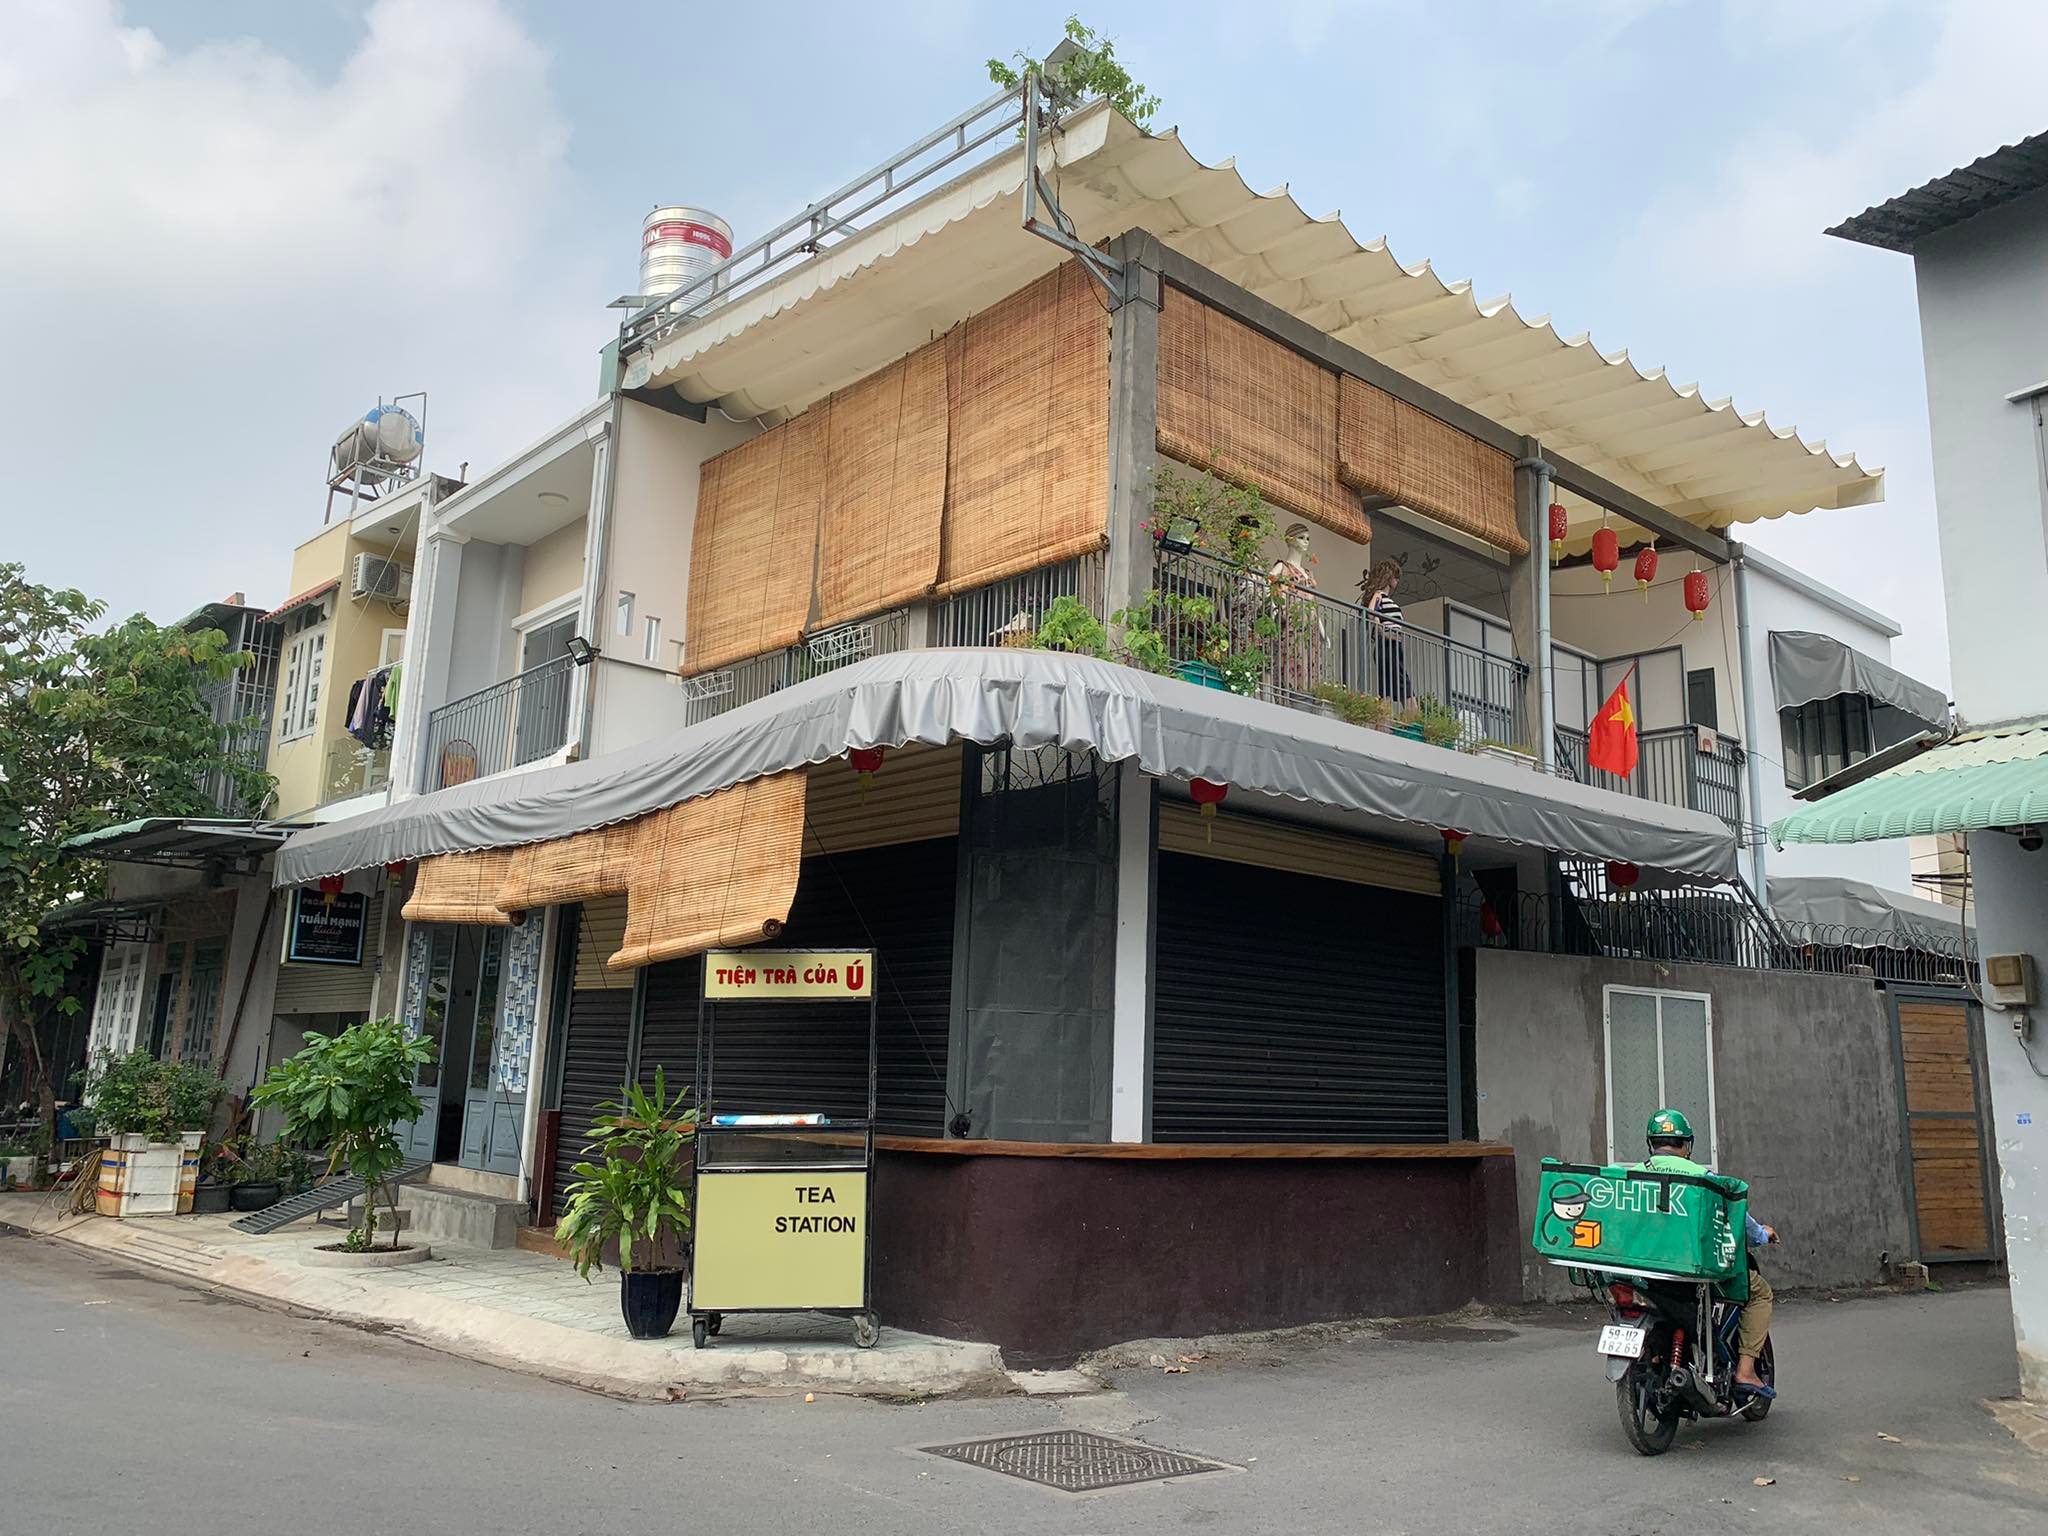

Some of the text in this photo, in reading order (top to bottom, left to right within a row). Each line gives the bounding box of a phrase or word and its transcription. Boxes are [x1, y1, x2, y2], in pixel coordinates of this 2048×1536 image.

[300, 912, 360, 929] TUẤN MẠNH
[716, 959, 864, 992] TIỆM TRÀ CỦA Ú
[795, 1187, 835, 1204] TEA
[1584, 1177, 1689, 1217] GHTK
[775, 1216, 856, 1233] STATION
